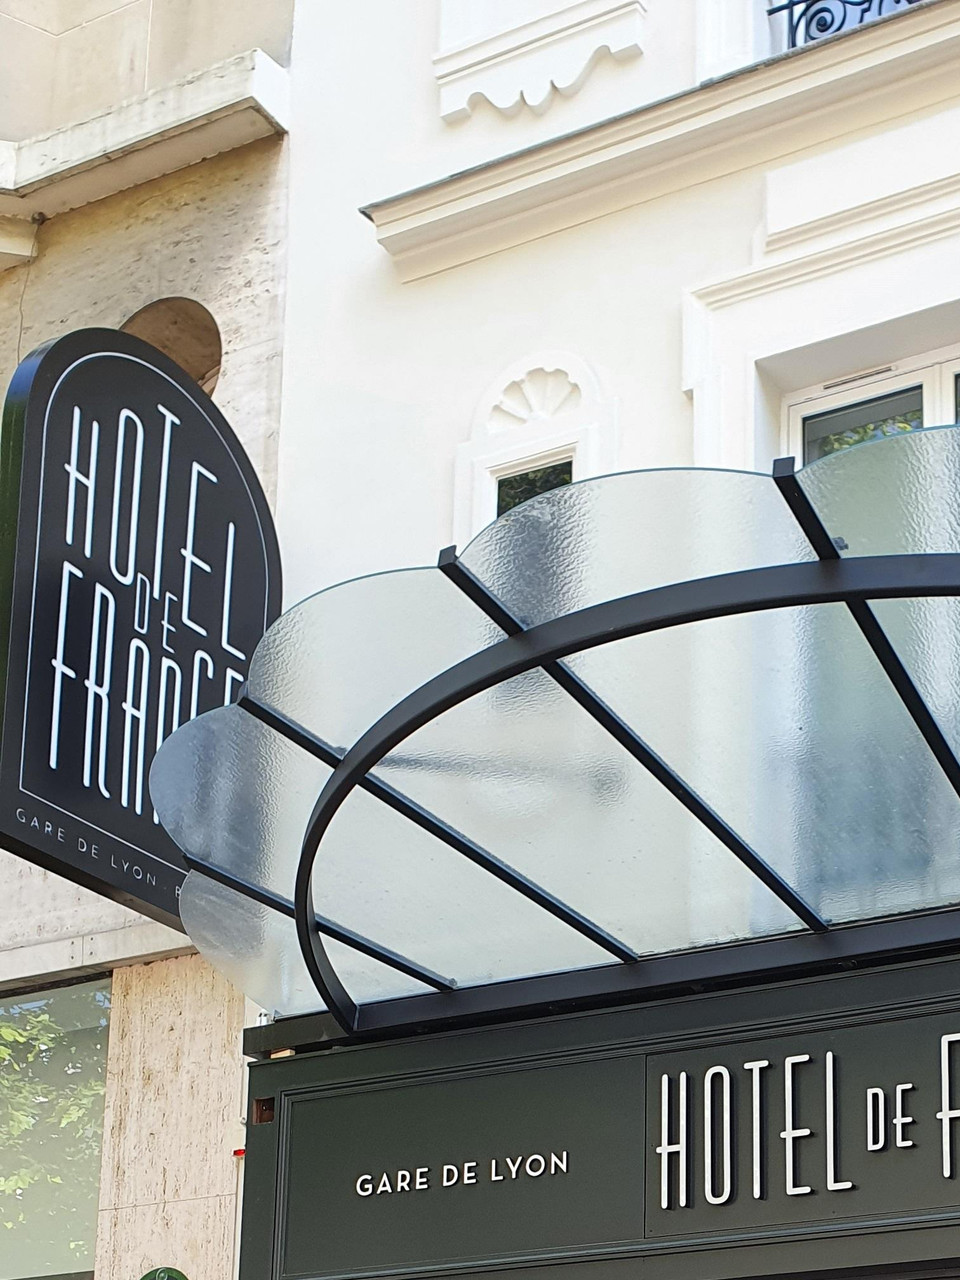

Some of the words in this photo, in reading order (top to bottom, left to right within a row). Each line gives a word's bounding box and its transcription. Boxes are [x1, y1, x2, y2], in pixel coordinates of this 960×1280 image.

[64, 404, 247, 661] HOTEL
[134, 572, 179, 654] DE
[16, 808, 65, 843] GARE
[78, 837, 99, 859] DE
[110, 854, 157, 886] LYON
[655, 1051, 854, 1210] HOTEL
[865, 1083, 914, 1151] DE
[355, 1167, 429, 1197] GARE
[442, 1161, 478, 1187] DE
[491, 1150, 568, 1182] LYON
